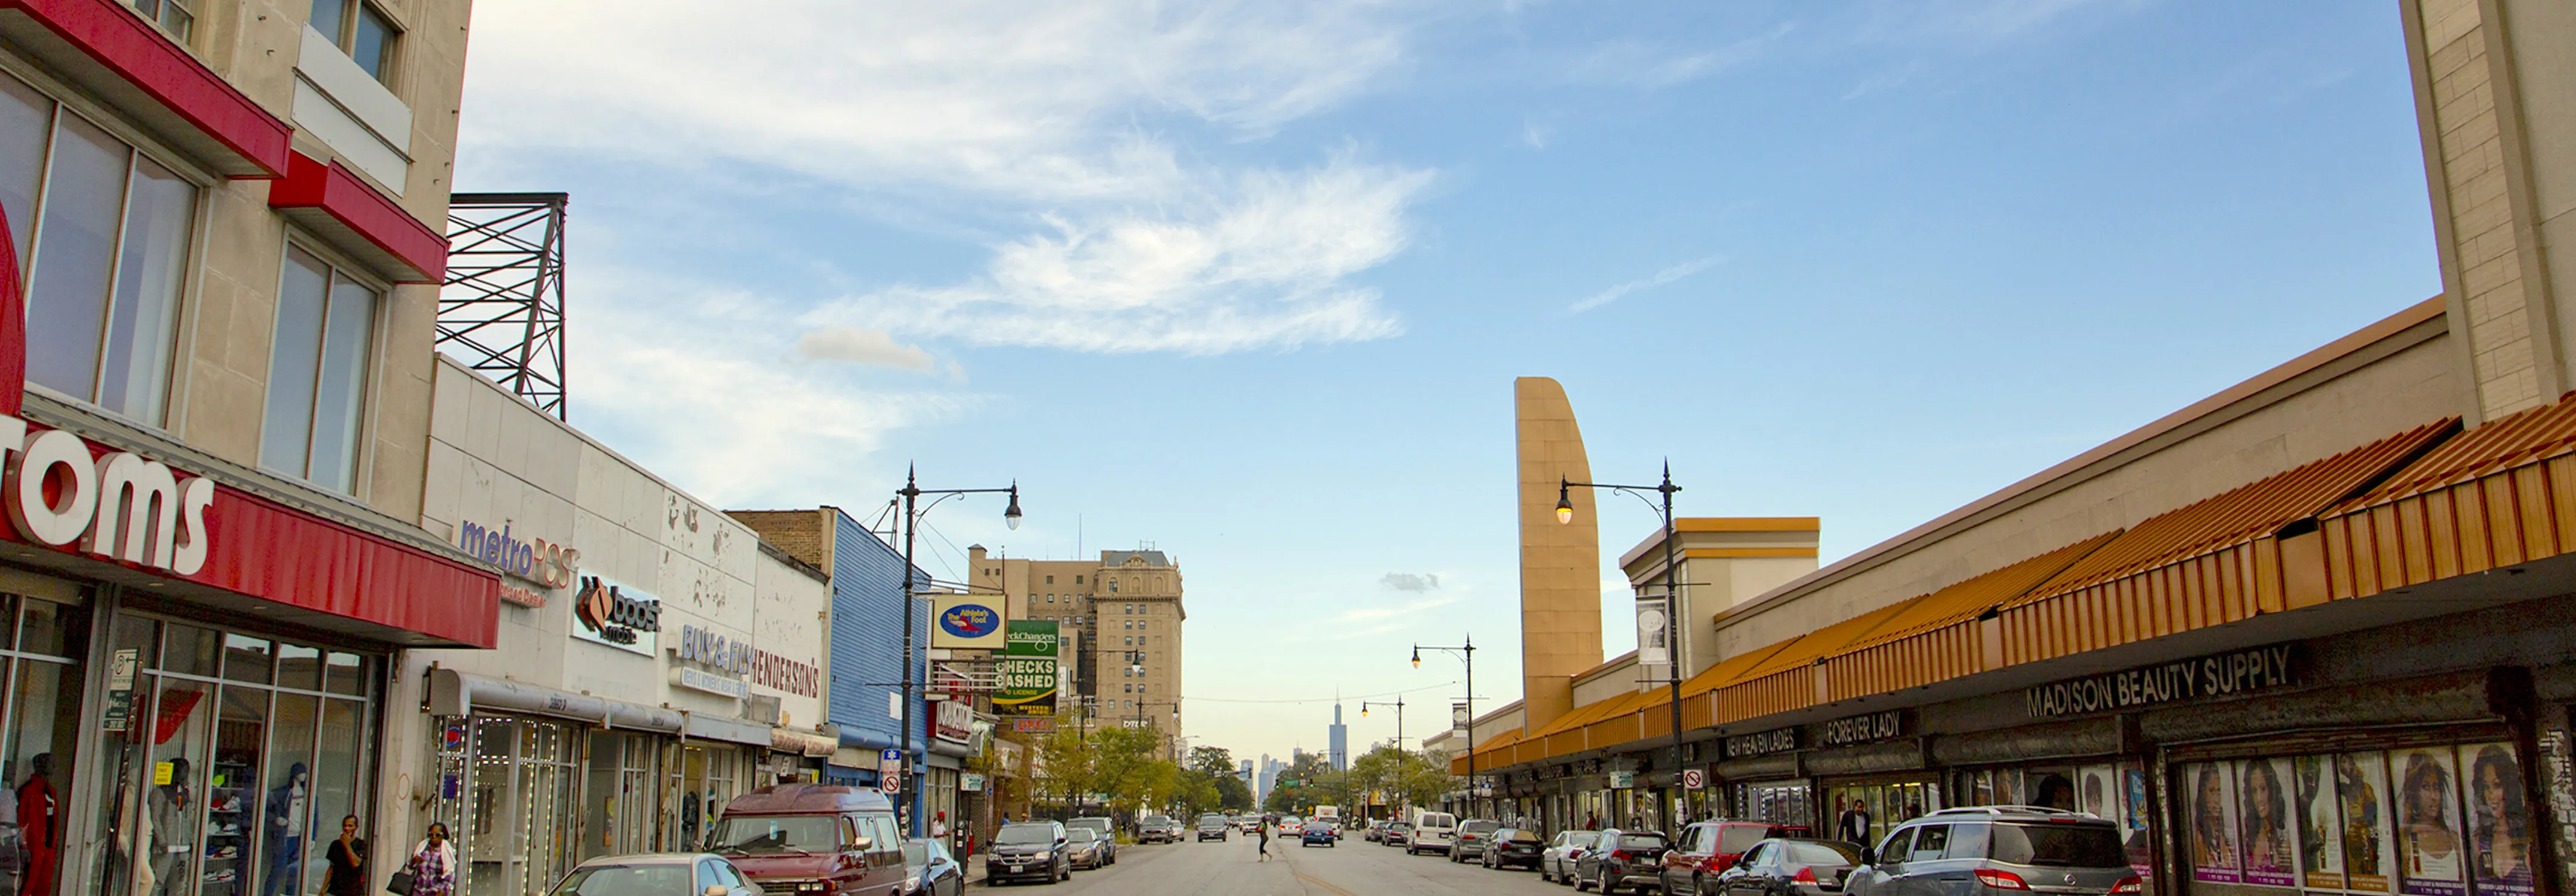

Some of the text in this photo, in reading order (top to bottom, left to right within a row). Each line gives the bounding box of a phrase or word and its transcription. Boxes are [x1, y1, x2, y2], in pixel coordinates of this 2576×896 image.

[460, 520, 573, 589] metroPCS
[610, 585, 662, 632] boost
[683, 624, 754, 674] BUY & FLY
[995, 660, 1054, 674] CHECKS
[753, 649, 819, 699] HENDERSON'S
[995, 674, 1054, 688] CASHED
[2027, 645, 2290, 718] MADISON BEAUTY SUPPLY
[1768, 727, 1794, 752] LADIES
[1827, 711, 1900, 744] FOREVER LADY
